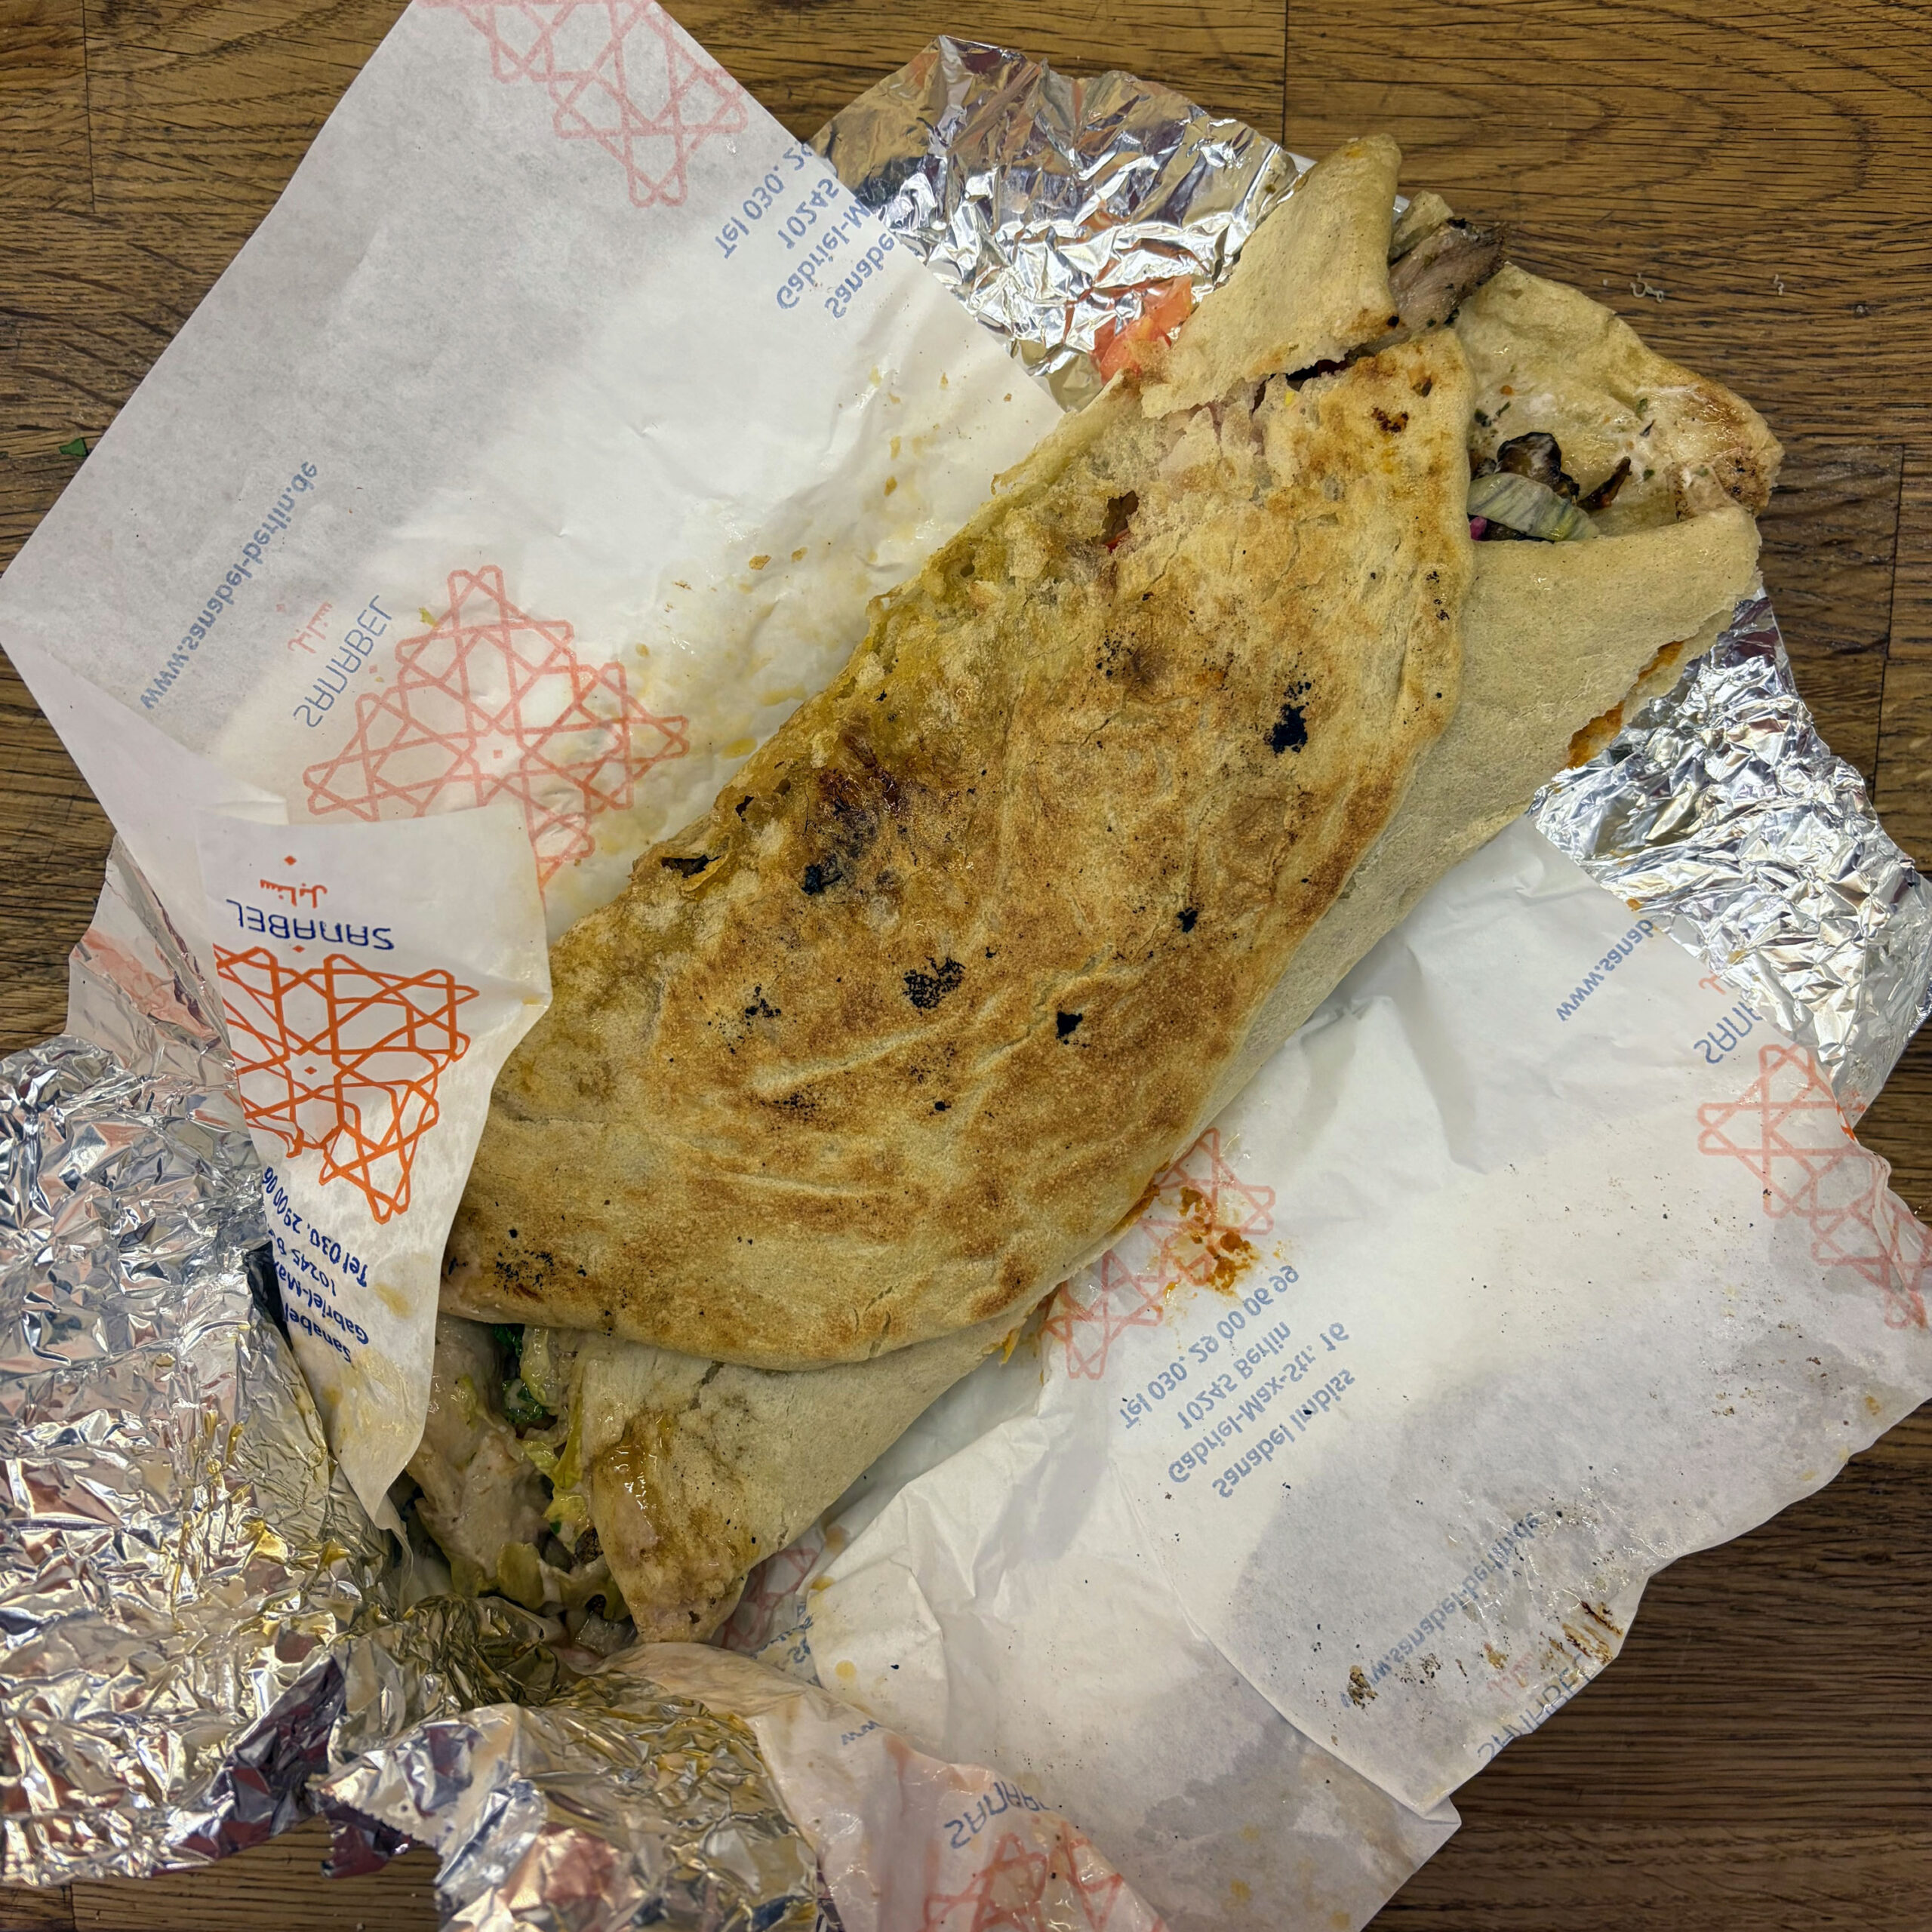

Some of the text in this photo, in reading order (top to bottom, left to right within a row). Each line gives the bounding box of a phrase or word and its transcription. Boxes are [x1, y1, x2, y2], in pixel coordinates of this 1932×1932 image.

[226, 899, 395, 950] SANABEL
[291, 1247, 336, 1297] 10245
[343, 1252, 368, 1287] Tel
[284, 1303, 352, 1363] Sanabel
